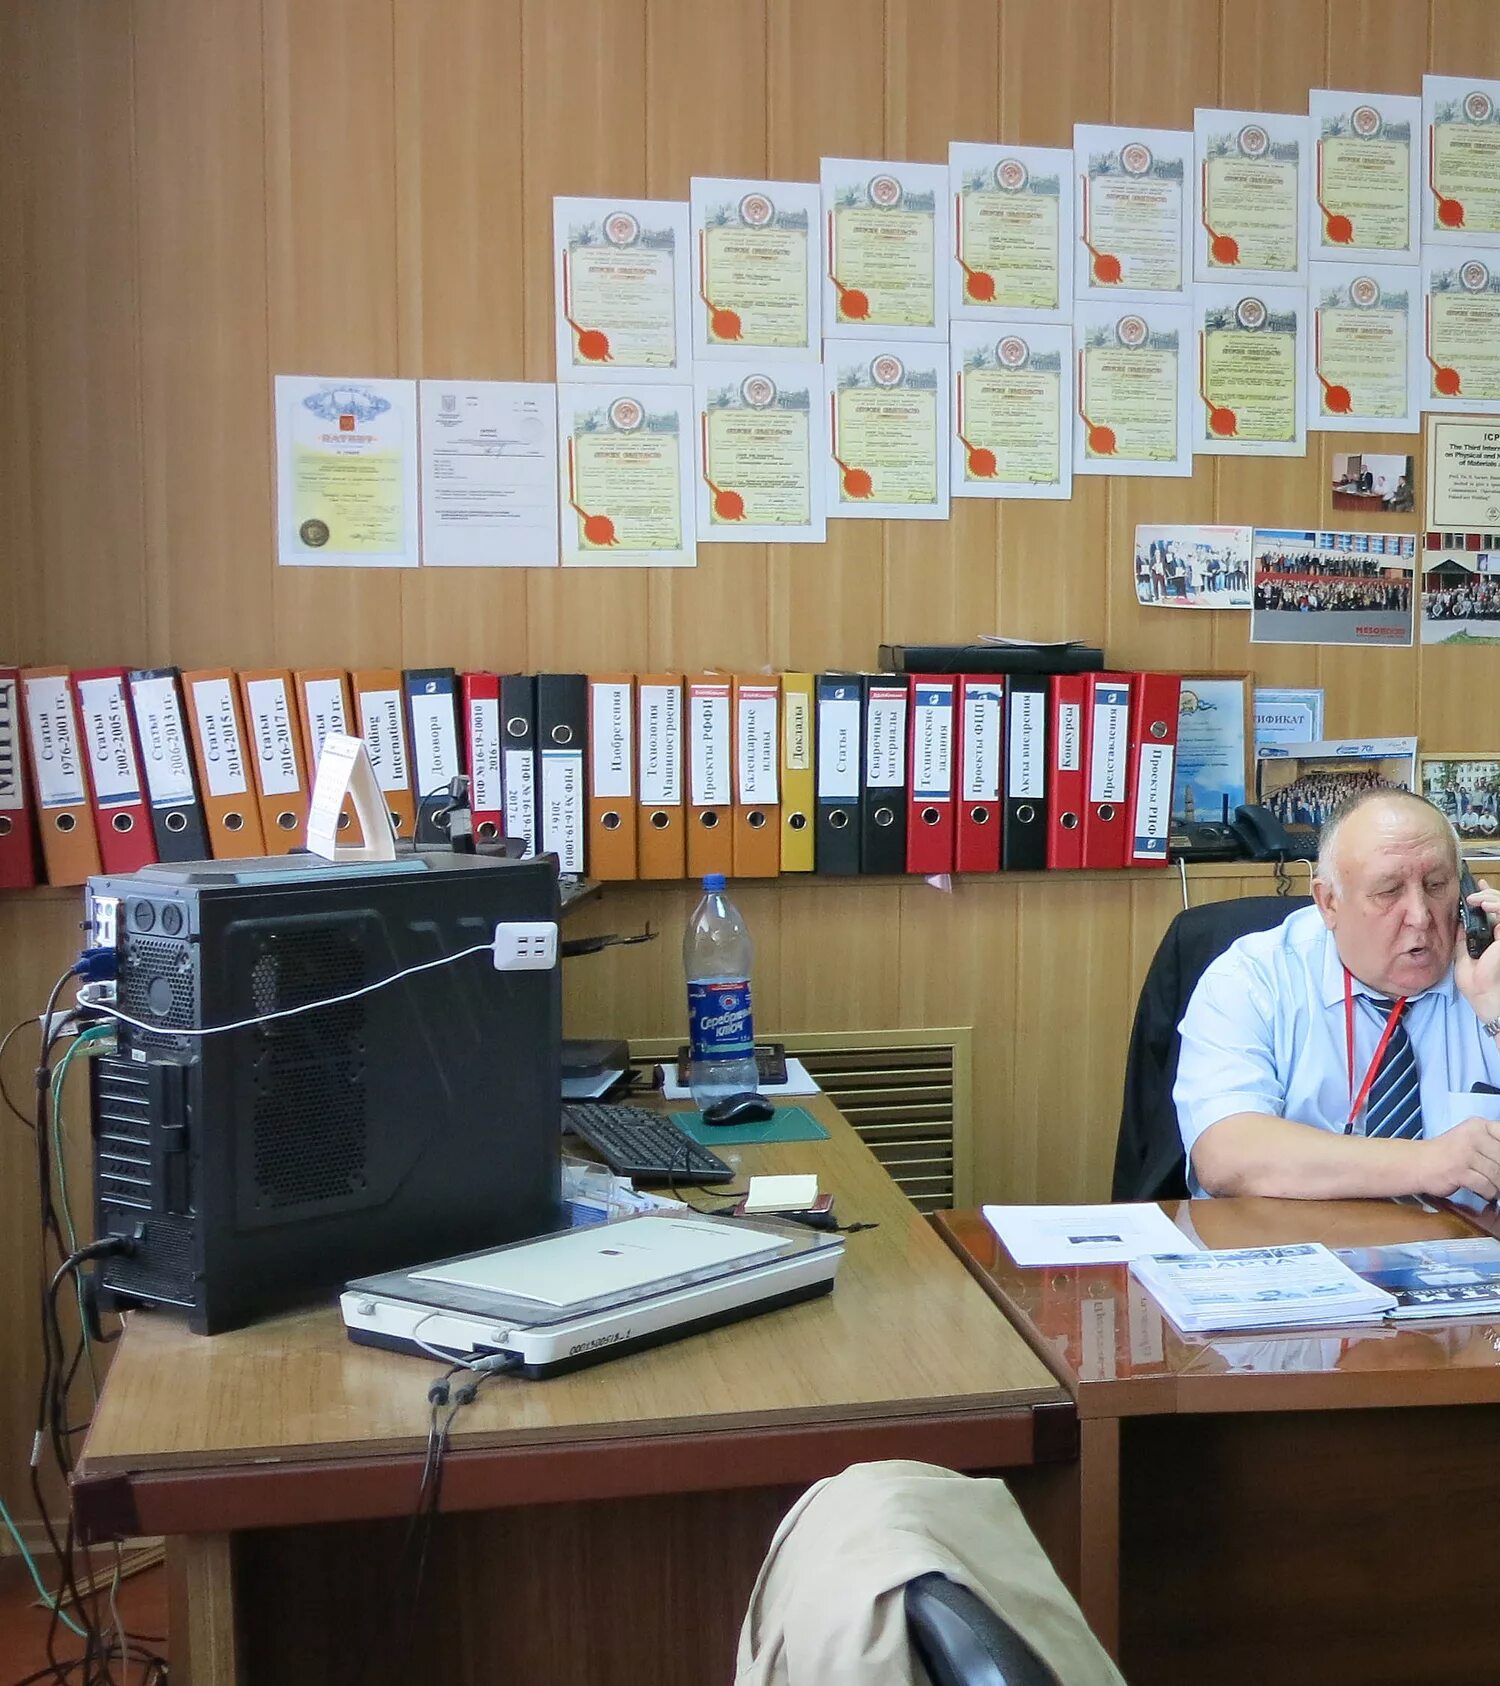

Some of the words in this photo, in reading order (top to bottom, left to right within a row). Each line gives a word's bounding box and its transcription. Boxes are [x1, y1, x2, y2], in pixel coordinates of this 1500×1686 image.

[1455, 451, 1482, 460] Physical
[39, 712, 54, 761] Статьи
[56, 713, 75, 776] 1976-2001
[93, 713, 109, 762] Статьи
[111, 714, 130, 777] 2002-2005
[148, 713, 163, 761] Статьи
[163, 713, 186, 777] 2006-2013
[205, 714, 220, 762] Статьи
[220, 715, 241, 777] 2014-2015
[259, 713, 274, 762] Статьи
[274, 713, 294, 777] 2016-2017
[368, 716, 382, 767] Welding
[384, 700, 402, 780] International
[431, 715, 445, 777] Договора
[473, 705, 486, 763] 16-19-10010
[611, 690, 623, 772] Изобретения
[646, 704, 658, 777] Технология
[662, 688, 677, 798] Машиностроения
[703, 699, 713, 741] РФФИ
[792, 705, 804, 764] Доклады
[870, 709, 883, 780] Сварочные
[887, 711, 899, 779] материалы
[974, 703, 985, 736] ФЦП
[1022, 694, 1032, 757] внедрения
[1062, 706, 1076, 768] Конкурсы
[1255, 714, 1305, 725] ИФИКАТ
[489, 746, 499, 771] 2016
[521, 756, 531, 781] РНФ
[703, 744, 717, 801] Проекты
[744, 708, 758, 793] Календарные
[762, 730, 771, 772] планы
[836, 727, 847, 774] Статьи
[921, 708, 934, 788] Технические
[939, 724, 949, 772] задания
[972, 739, 985, 793] Проекты
[1103, 707, 1118, 799] Представления
[476, 776, 487, 805] РНФ
[508, 789, 519, 815] 2017
[564, 767, 574, 793] РНФ
[1020, 761, 1031, 795] Акты
[1149, 749, 1162, 803] Проекты
[550, 800, 561, 825] 2016
[564, 807, 576, 868] 16-19-10010
[1147, 806, 1160, 836] РНФ
